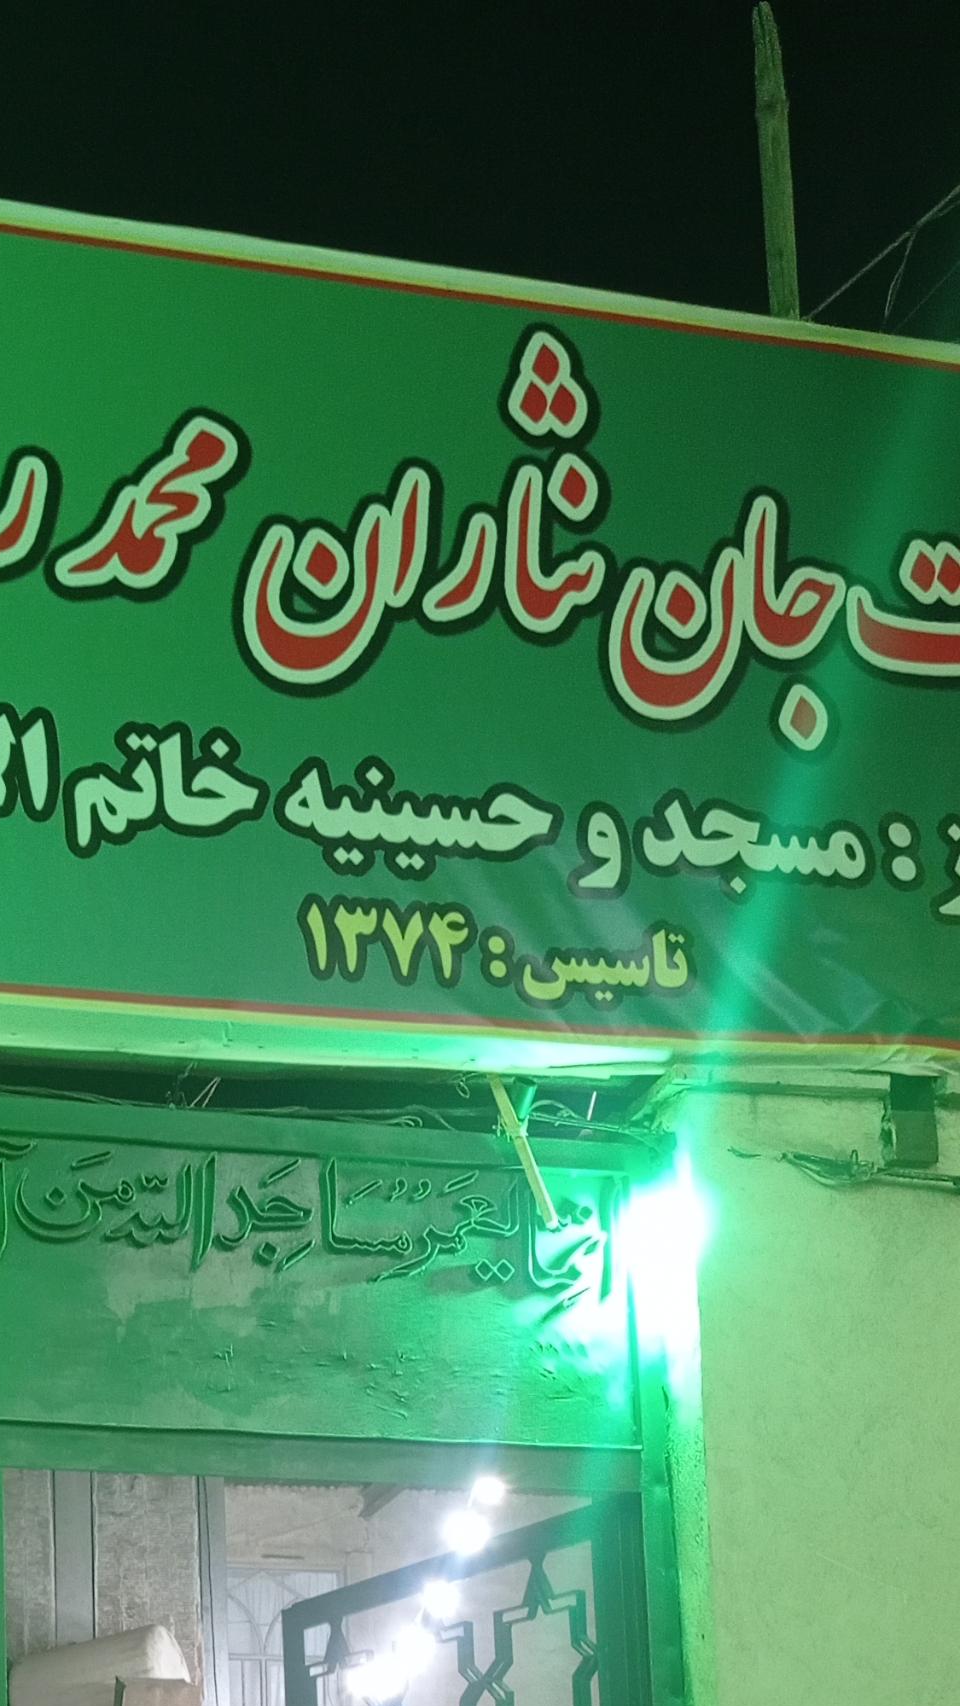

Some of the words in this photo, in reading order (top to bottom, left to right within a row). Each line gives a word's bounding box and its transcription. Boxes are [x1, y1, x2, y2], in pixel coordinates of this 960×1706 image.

[55, 416, 239, 588] محمد
[244, 331, 606, 685] نثاران
[608, 495, 845, 751] جان
[74, 732, 260, 848] خاتم
[282, 766, 553, 869] حسینیه
[577, 812, 622, 889] و
[643, 798, 867, 896] مسجد
[306, 901, 470, 980] ۱۳۷۴
